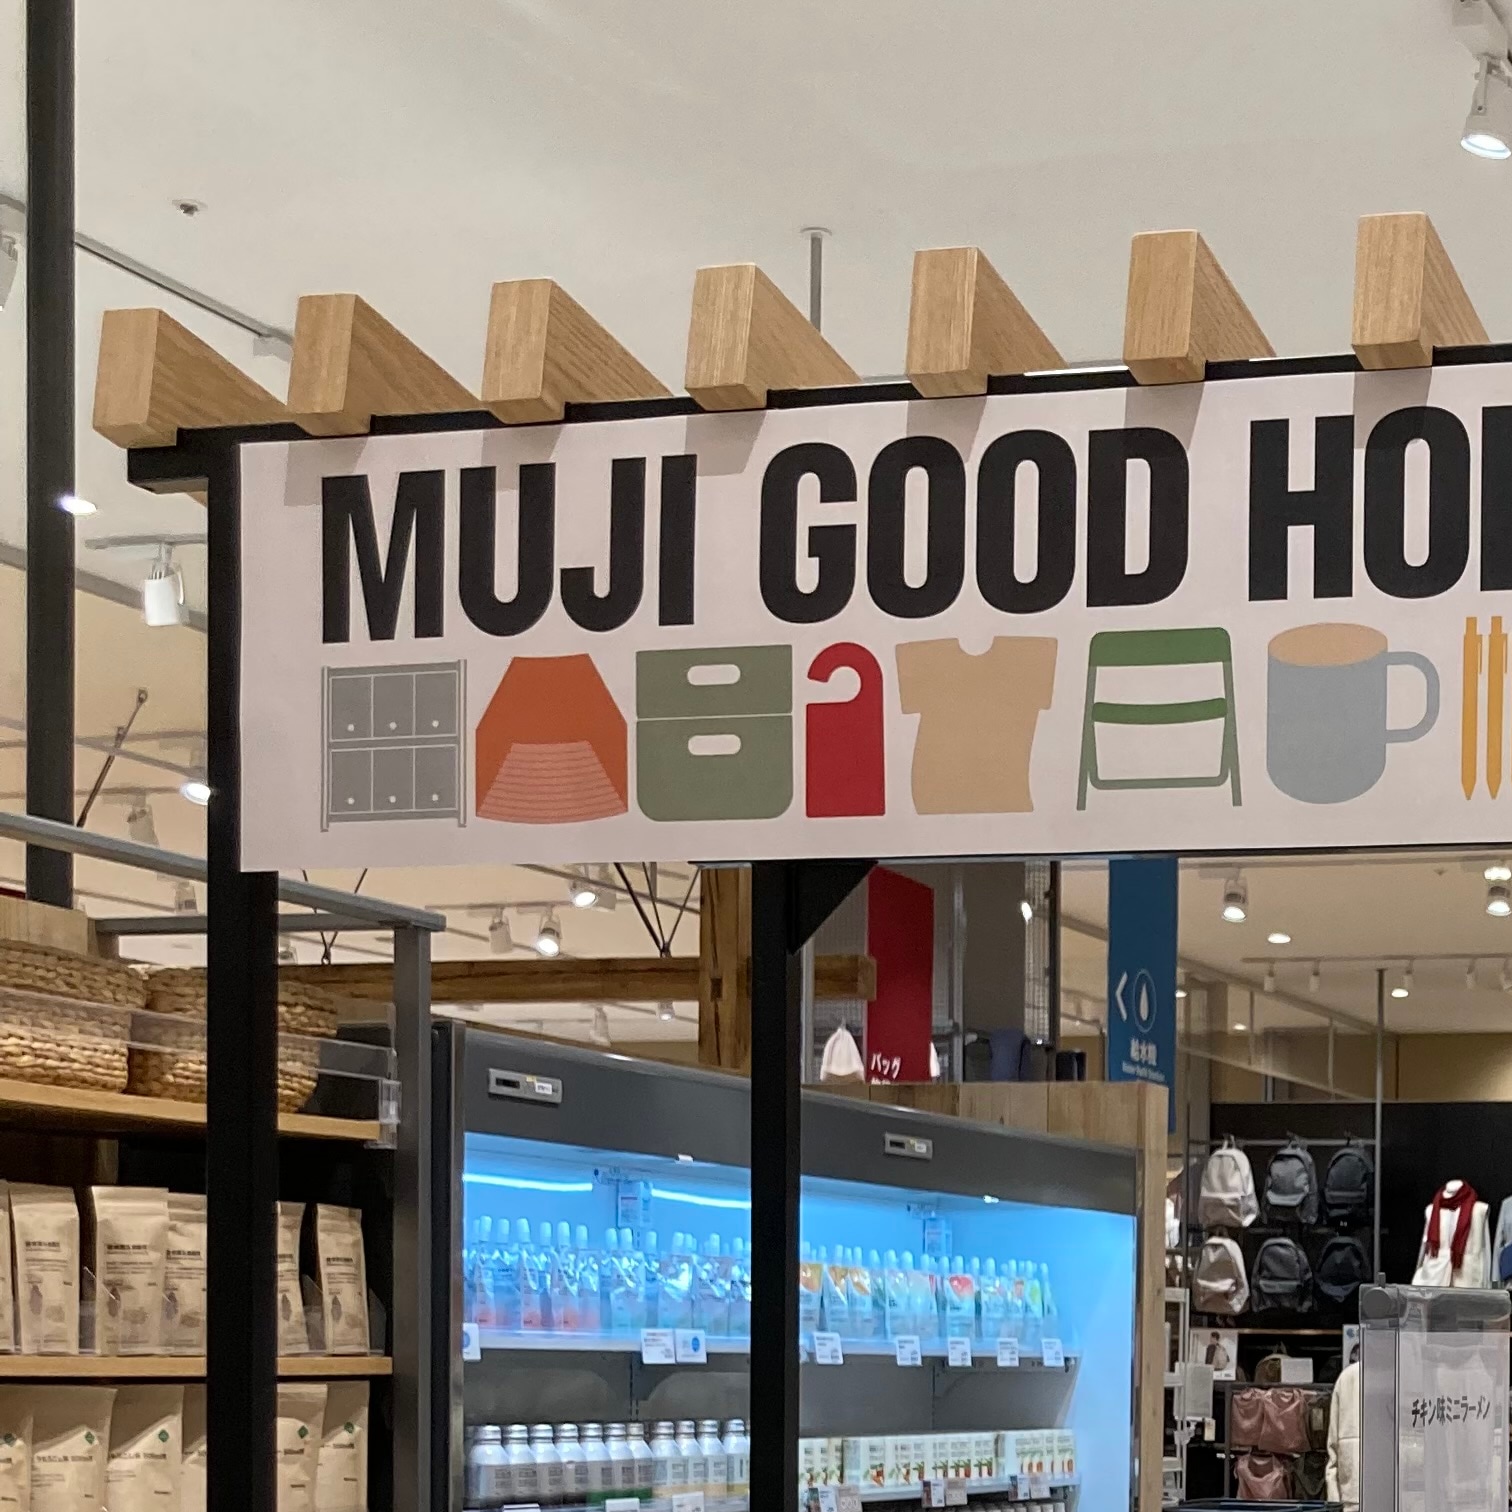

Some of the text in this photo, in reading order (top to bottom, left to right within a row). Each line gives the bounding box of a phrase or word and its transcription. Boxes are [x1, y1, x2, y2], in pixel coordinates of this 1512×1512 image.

[321, 452, 698, 645] MUJI
[759, 423, 1190, 625] GOOD
[871, 1052, 901, 1080] バッグ
[1411, 1396, 1491, 1427] チキン味ミニラーメン
